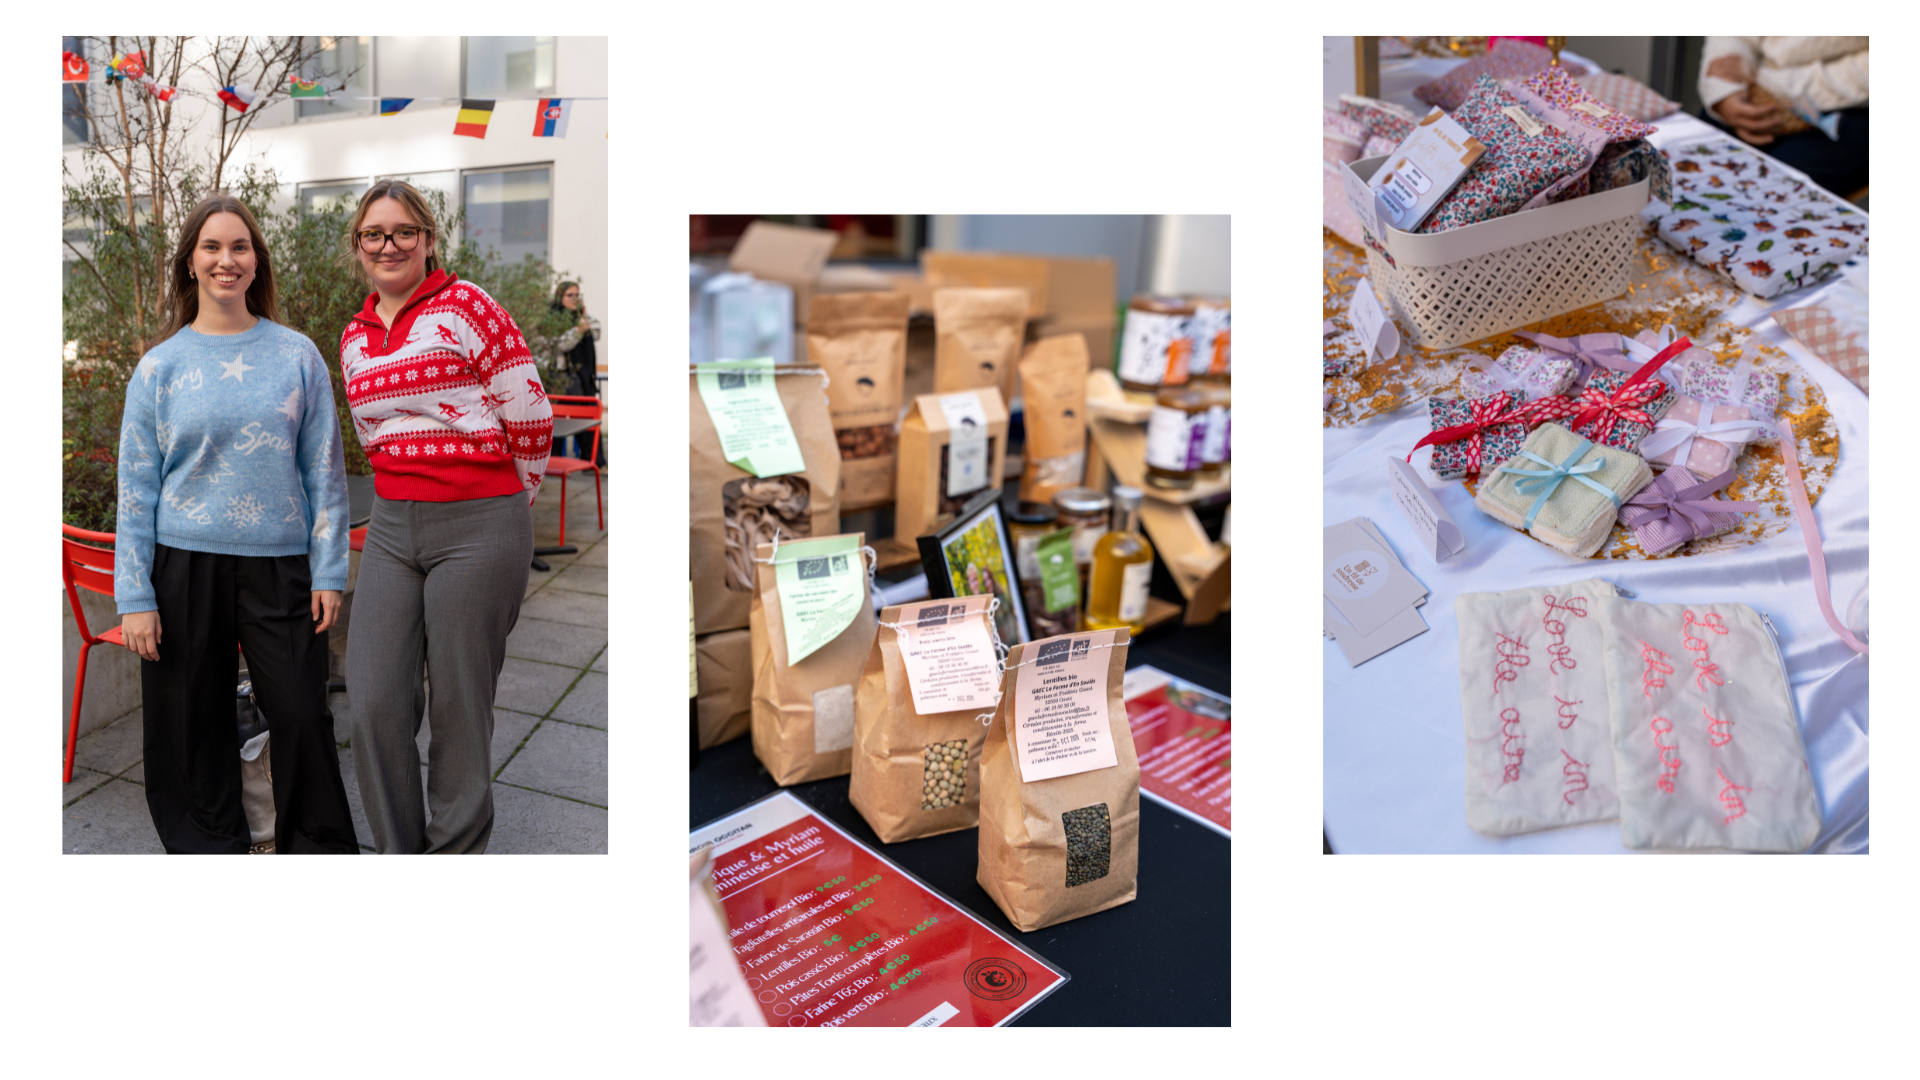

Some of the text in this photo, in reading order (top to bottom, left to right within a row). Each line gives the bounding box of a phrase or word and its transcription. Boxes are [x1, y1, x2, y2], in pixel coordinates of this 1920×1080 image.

[156, 368, 203, 402] erry
[1043, 676, 1067, 684] Lentilles
[1494, 632, 1530, 694] the
[710, 859, 748, 882] rique
[750, 851, 766, 862] &
[765, 826, 820, 854] Myriam
[713, 836, 824, 893] mineuse et huile
[732, 926, 783, 955] Tagliatelles
[782, 905, 825, 930] artisanales
[824, 898, 834, 908] et
[853, 874, 882, 892] 3€50
[744, 920, 757, 930] de
[756, 900, 797, 924] tournesol
[816, 876, 846, 892] 9€50
[746, 948, 778, 968] Farine
[776, 942, 791, 952] de
[788, 924, 826, 945] Sarassin
[844, 898, 874, 916] 5€50
[760, 956, 800, 980] Lentilles
[823, 934, 842, 946] 5€
[790, 985, 820, 1006] Pâtes
[817, 970, 845, 990] Tortis
[844, 946, 888, 974] complètes
[909, 916, 938, 936] 4€50
[776, 978, 800, 994] Pois
[798, 963, 827, 982] cassés
[849, 932, 880, 952] 4€50
[804, 996, 838, 1019] Farine
[834, 986, 858, 1000] T65
[879, 954, 910, 975] 4€50
[843, 1002, 868, 1018] verts
[890, 968, 922, 990] 4€50
[916, 1015, 938, 1028] aux
